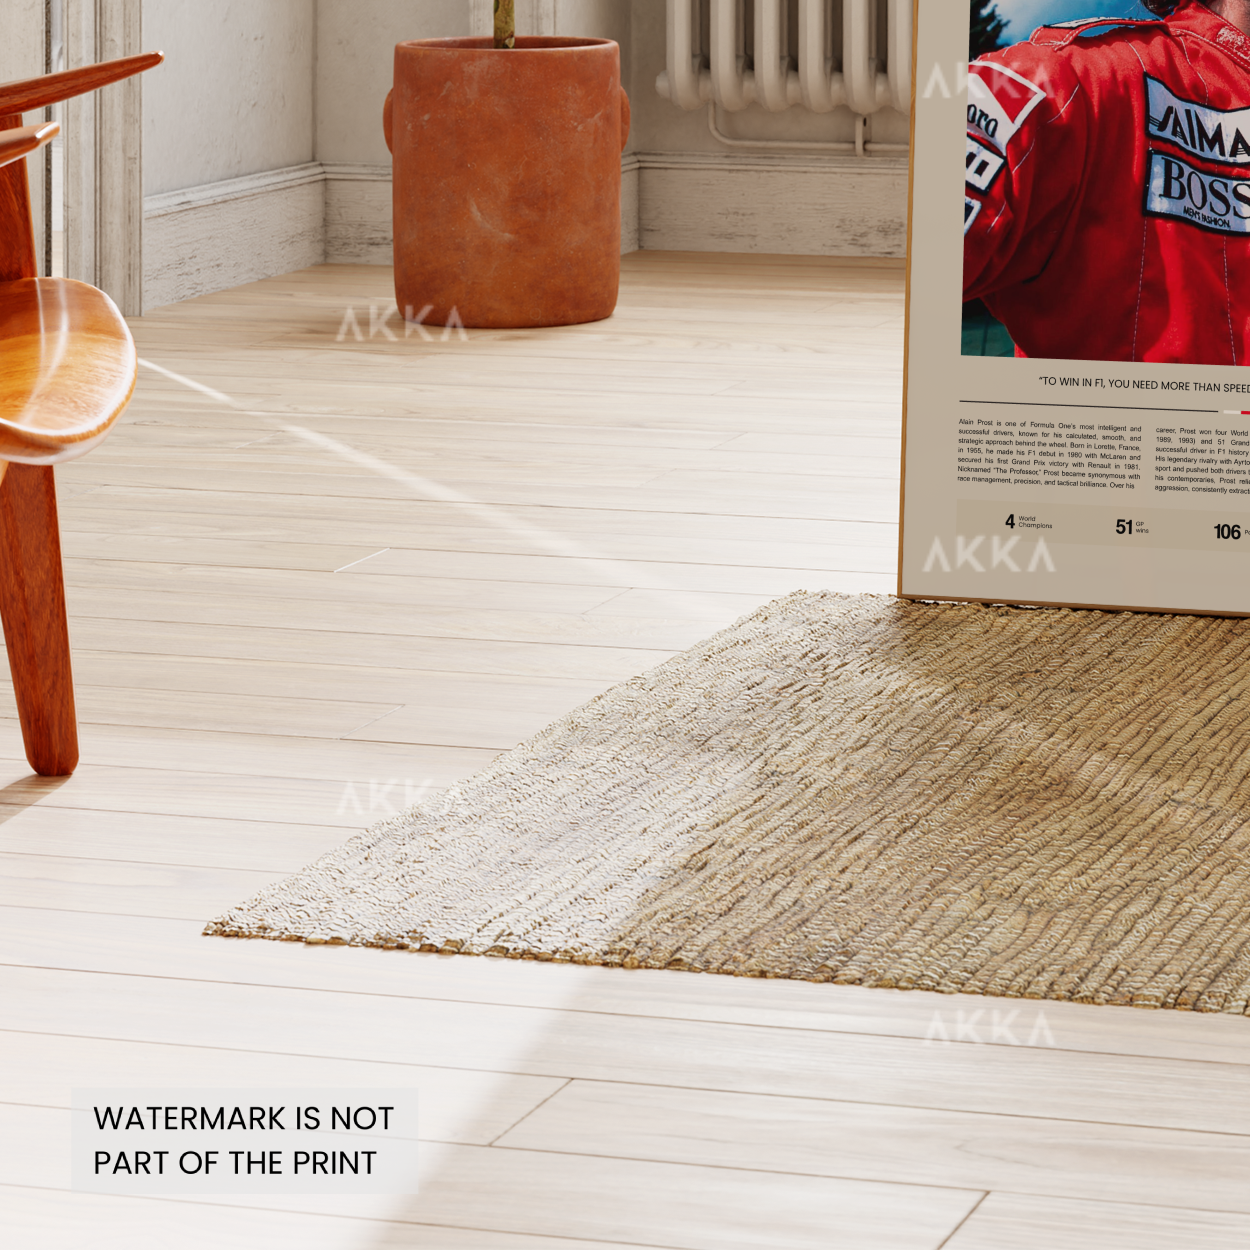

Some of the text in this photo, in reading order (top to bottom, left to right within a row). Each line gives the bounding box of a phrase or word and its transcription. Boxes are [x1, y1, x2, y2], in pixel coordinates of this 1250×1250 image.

[1038, 376, 1056, 385] “TO
[1059, 377, 1079, 386] WIN
[1082, 378, 1092, 387] IN
[1095, 378, 1105, 388] F1,
[1108, 379, 1129, 388] YOU
[1132, 380, 1158, 389] NEED
[1161, 381, 1190, 390] MORE
[1193, 382, 1220, 391] THAN
[1005, 514, 1016, 529] 4
[1115, 519, 1133, 535] 51
[1213, 524, 1242, 540] 106
